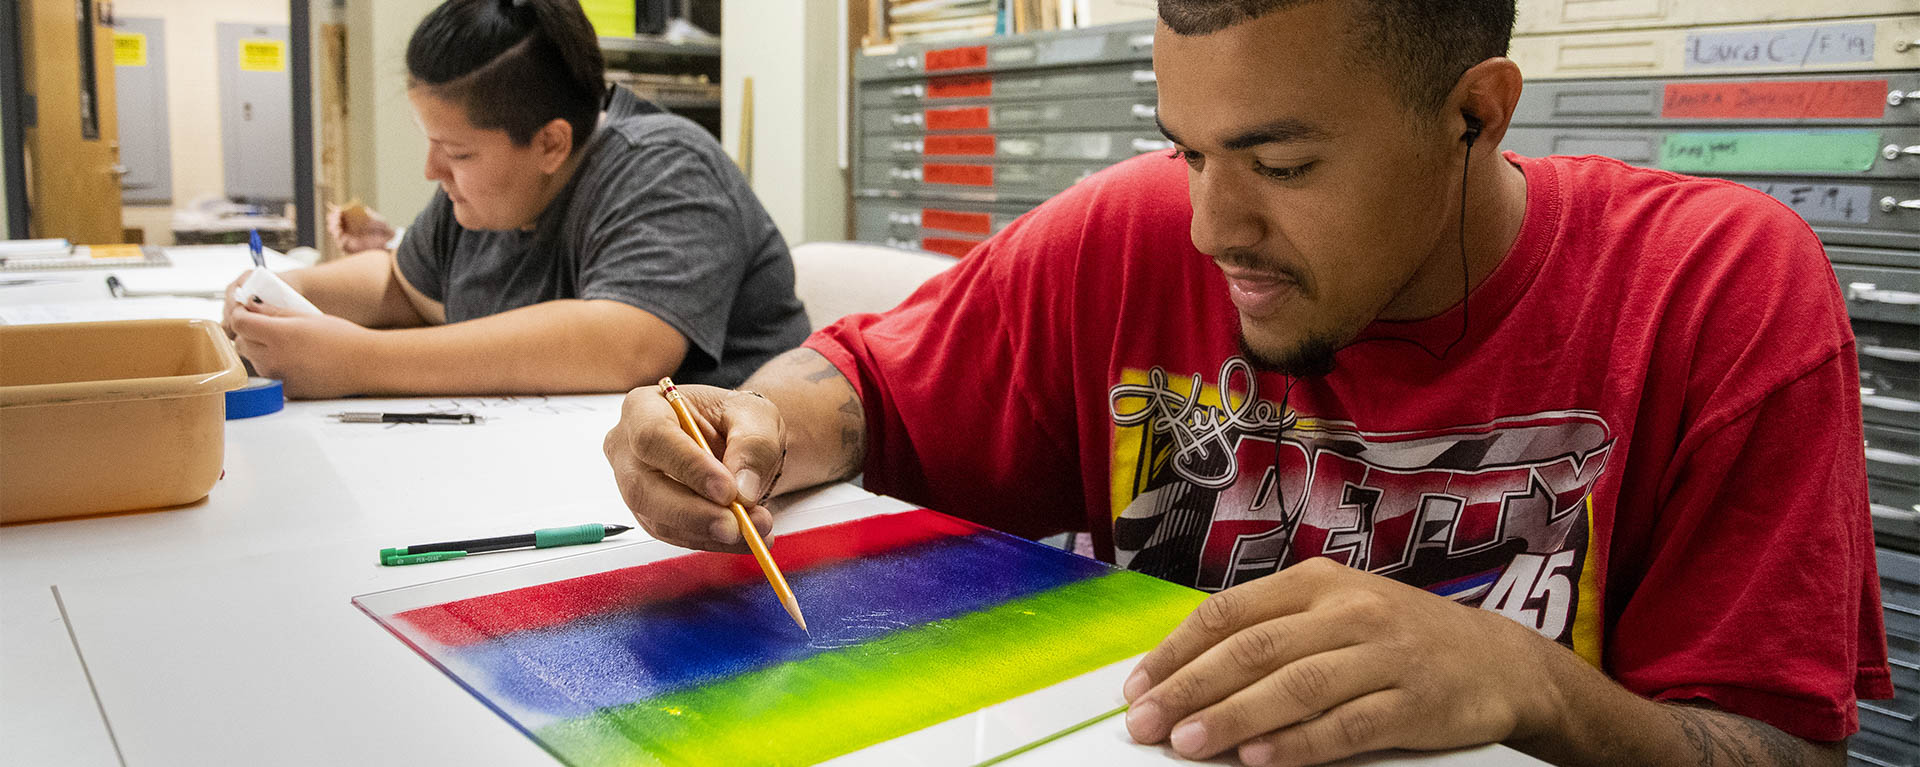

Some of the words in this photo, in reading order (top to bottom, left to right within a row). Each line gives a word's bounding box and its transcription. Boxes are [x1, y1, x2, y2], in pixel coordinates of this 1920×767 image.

[1109, 356, 1297, 489] Kyle
[1196, 434, 1618, 591] PETTY
[1480, 549, 1577, 641] 45
